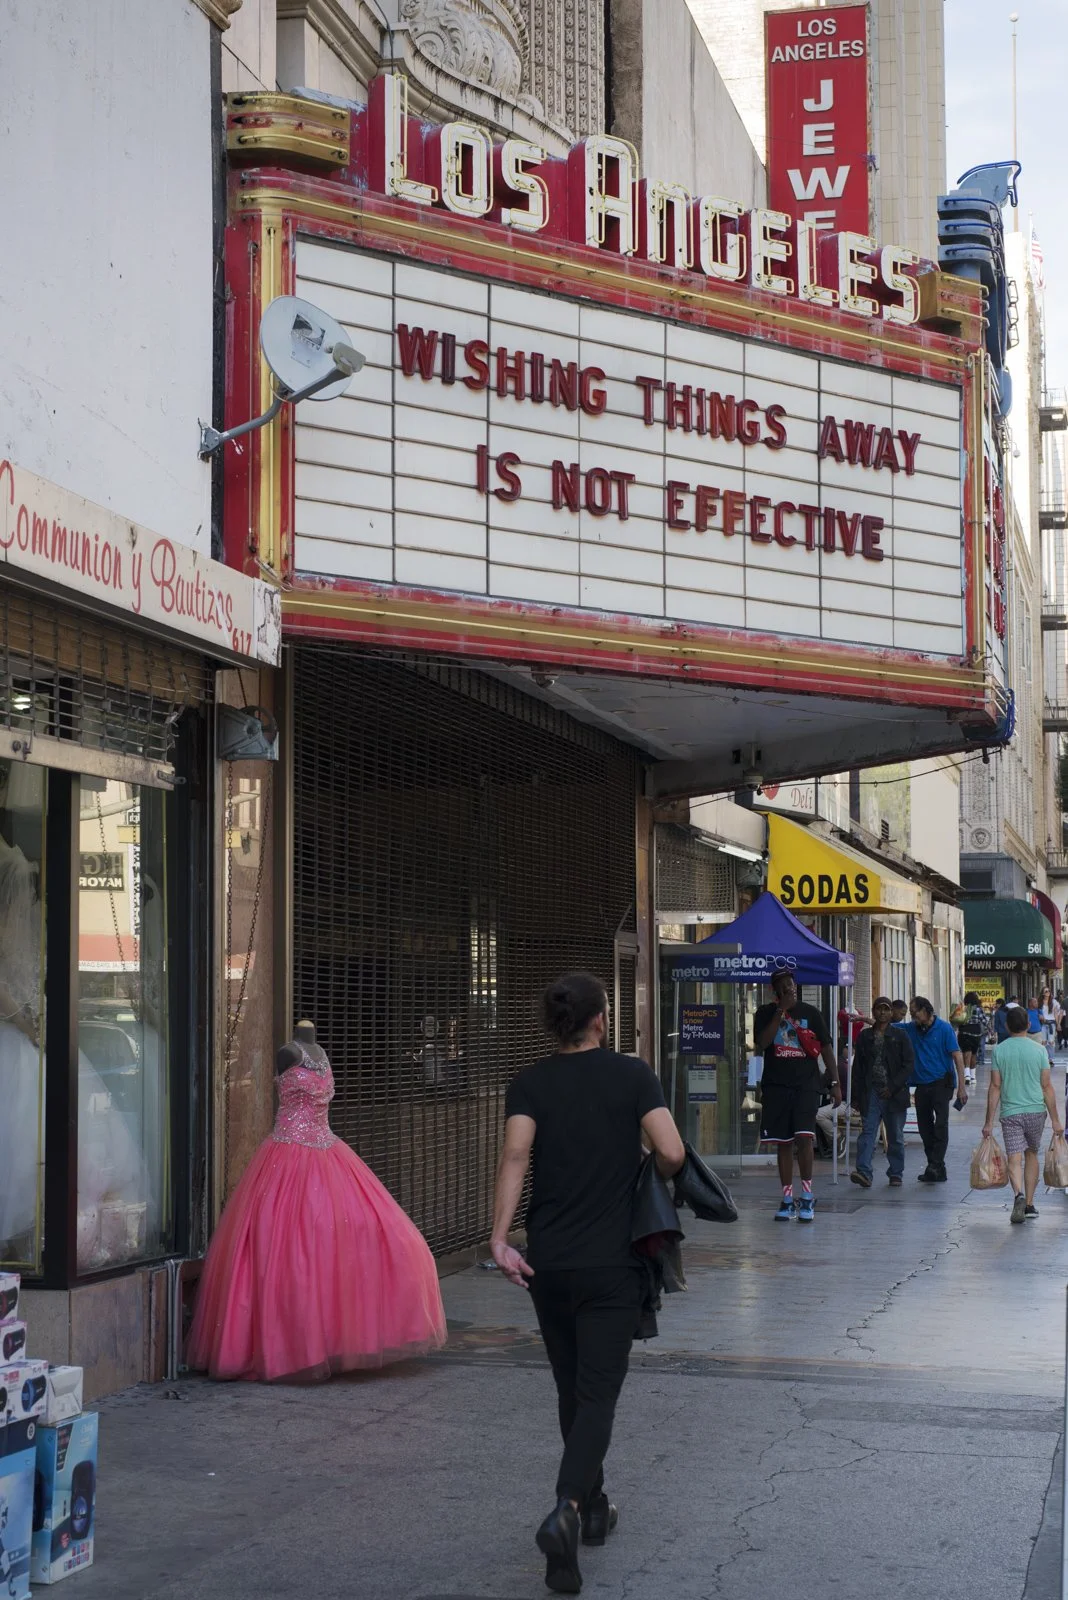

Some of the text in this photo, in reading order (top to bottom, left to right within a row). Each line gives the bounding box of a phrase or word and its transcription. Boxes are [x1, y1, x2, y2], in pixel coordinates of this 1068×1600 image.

[797, 18, 837, 37] LOS
[771, 40, 864, 63] ANGELES
[384, 72, 922, 326] LOS ANGELES
[397, 323, 922, 476] WISHING THINGS AWAY
[476, 444, 885, 562] IS NOT EFFECTIVE
[0, 460, 123, 591] Communion
[132, 552, 142, 614] y
[232, 628, 253, 656] 617
[791, 787, 813, 809] Deli
[780, 873, 869, 905] SODAS
[1028, 943, 1042, 954] 561
[672, 965, 710, 977] metro
[713, 955, 797, 969] metroPCS
[967, 960, 992, 970] PAWN
[995, 960, 1017, 970] SHOP
[683, 1009, 718, 1018] MetroPCS
[683, 1031, 721, 1040] by T-Mobile
